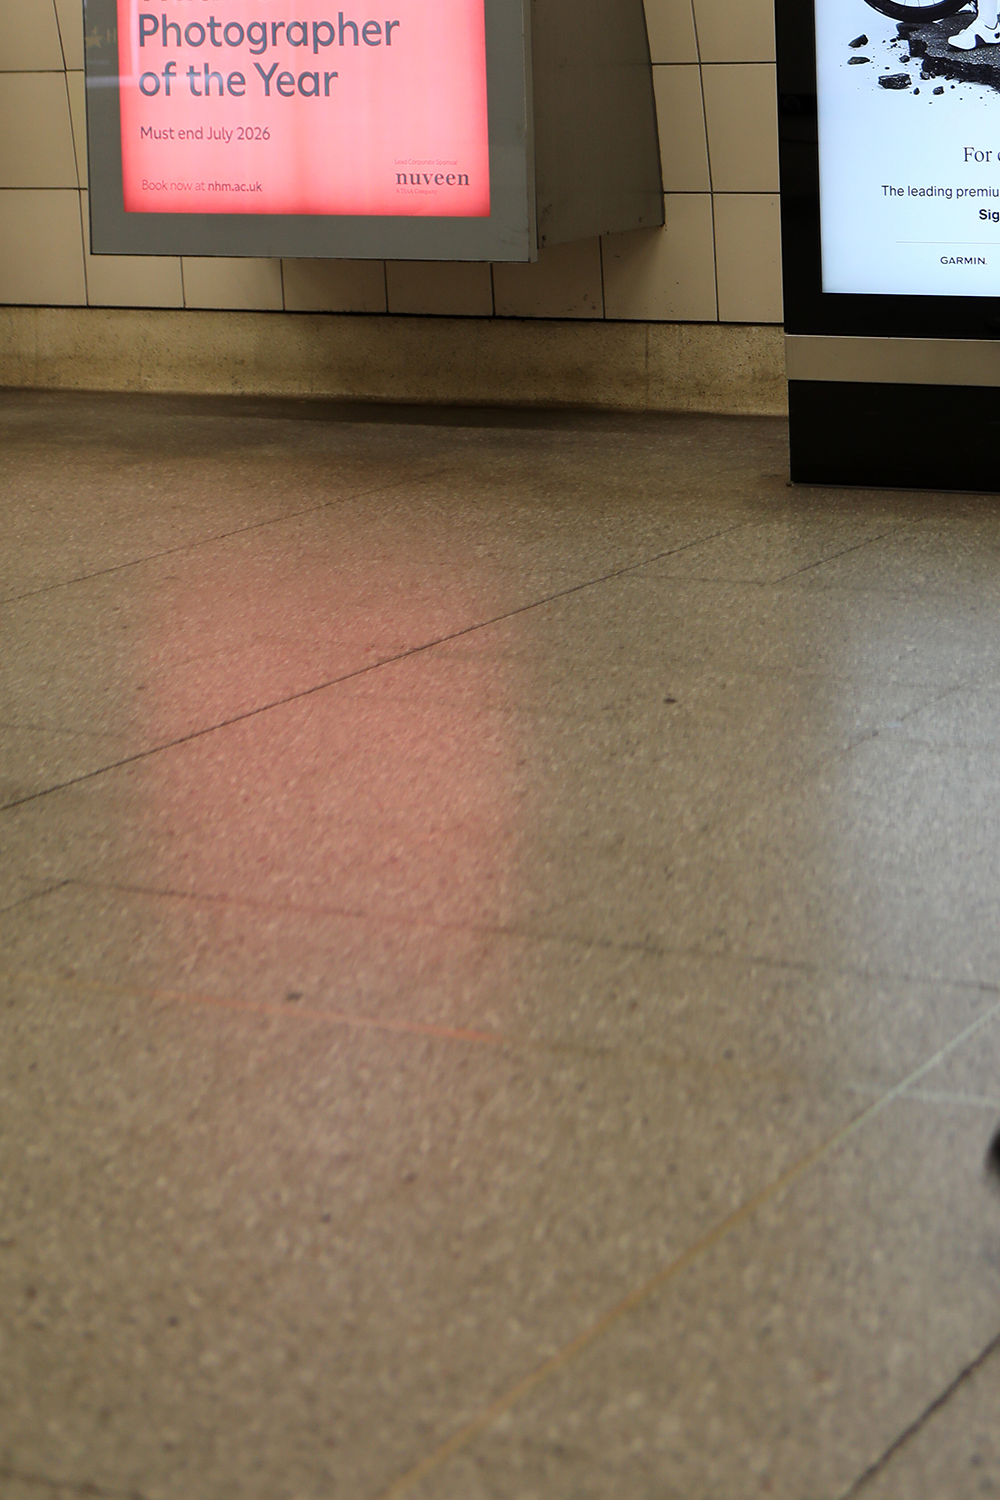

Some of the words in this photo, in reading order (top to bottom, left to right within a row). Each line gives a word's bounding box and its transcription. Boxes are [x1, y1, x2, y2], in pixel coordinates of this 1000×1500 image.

[138, 12, 400, 54] Photographer
[138, 61, 177, 97] of
[186, 62, 247, 97] the
[253, 62, 339, 97] Year
[140, 126, 175, 140] Must
[178, 126, 204, 140] end
[207, 126, 234, 144] July
[236, 127, 271, 140] 2026
[963, 146, 993, 162] For
[142, 179, 168, 191] Book
[170, 182, 193, 191] now
[195, 181, 206, 192] at
[208, 181, 263, 192] nhm.ac.uk
[395, 172, 470, 186] nuveen
[881, 184, 905, 197] The
[907, 185, 953, 200] leading
